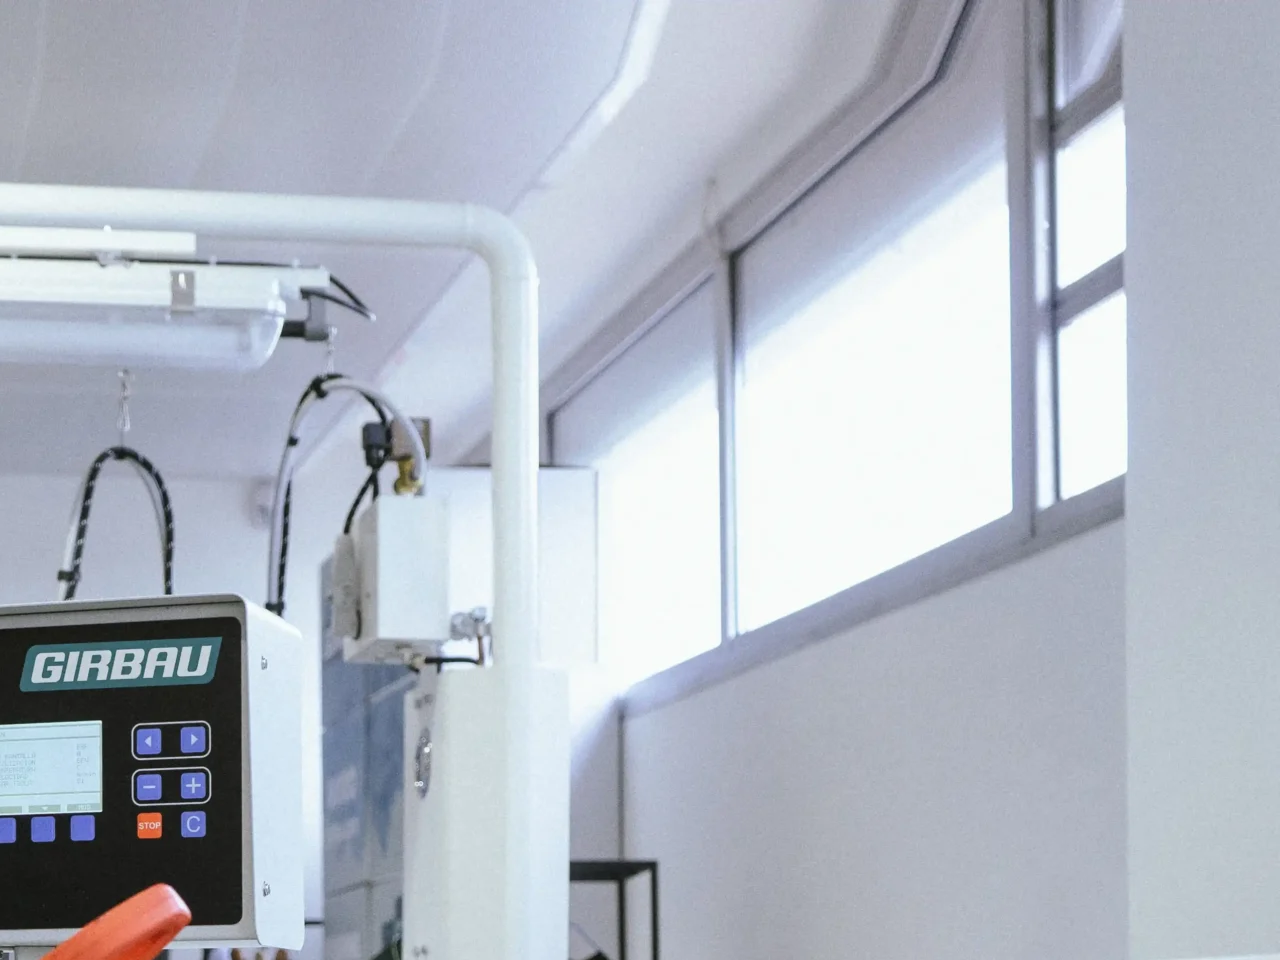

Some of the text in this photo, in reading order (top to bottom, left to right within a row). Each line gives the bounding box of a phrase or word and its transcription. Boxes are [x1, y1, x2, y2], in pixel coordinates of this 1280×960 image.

[31, 645, 212, 684] GIRBAU
[138, 821, 161, 831] STOP
[186, 816, 200, 833] C
